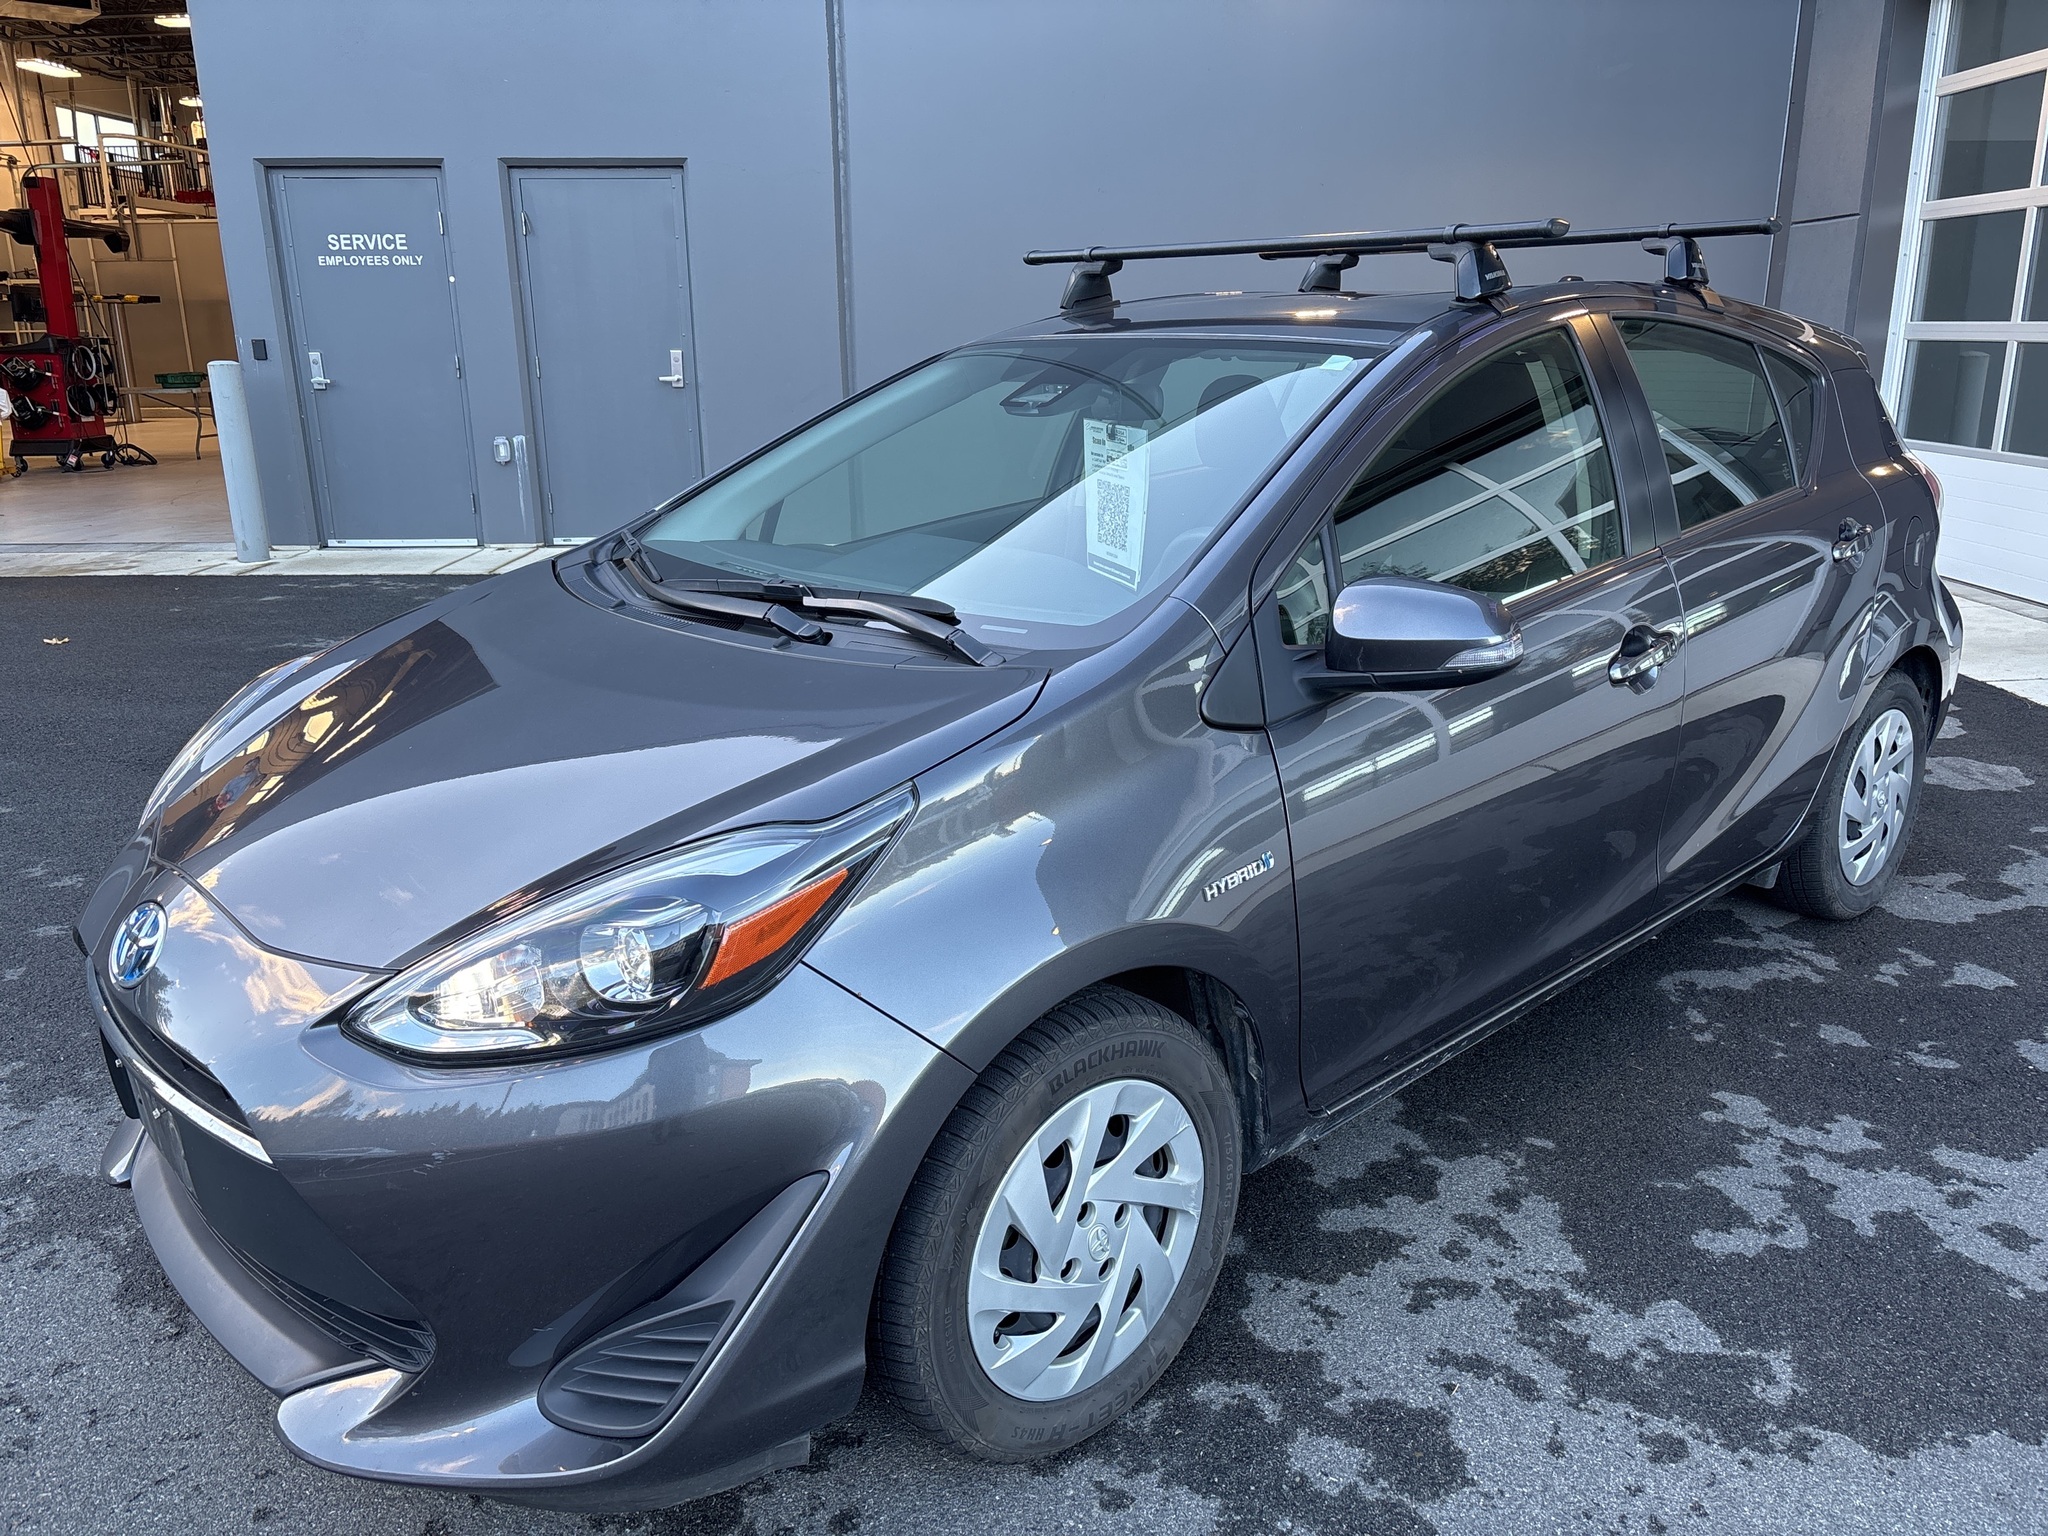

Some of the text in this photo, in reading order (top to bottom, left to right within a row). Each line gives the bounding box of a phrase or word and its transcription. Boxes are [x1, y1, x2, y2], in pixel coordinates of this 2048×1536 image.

[318, 255, 423, 266] EMPLOYEES ONLY
[327, 233, 408, 251] SERVICE
[1203, 859, 1267, 902] HYBRID
[1048, 1039, 1165, 1096] BLACKHAWK
[1223, 1131, 1234, 1208] 175/65R15
[944, 1305, 956, 1363] OUTSIDE
[1051, 1346, 1169, 1437] STREET-H
[1011, 1426, 1045, 1441] HH4S
